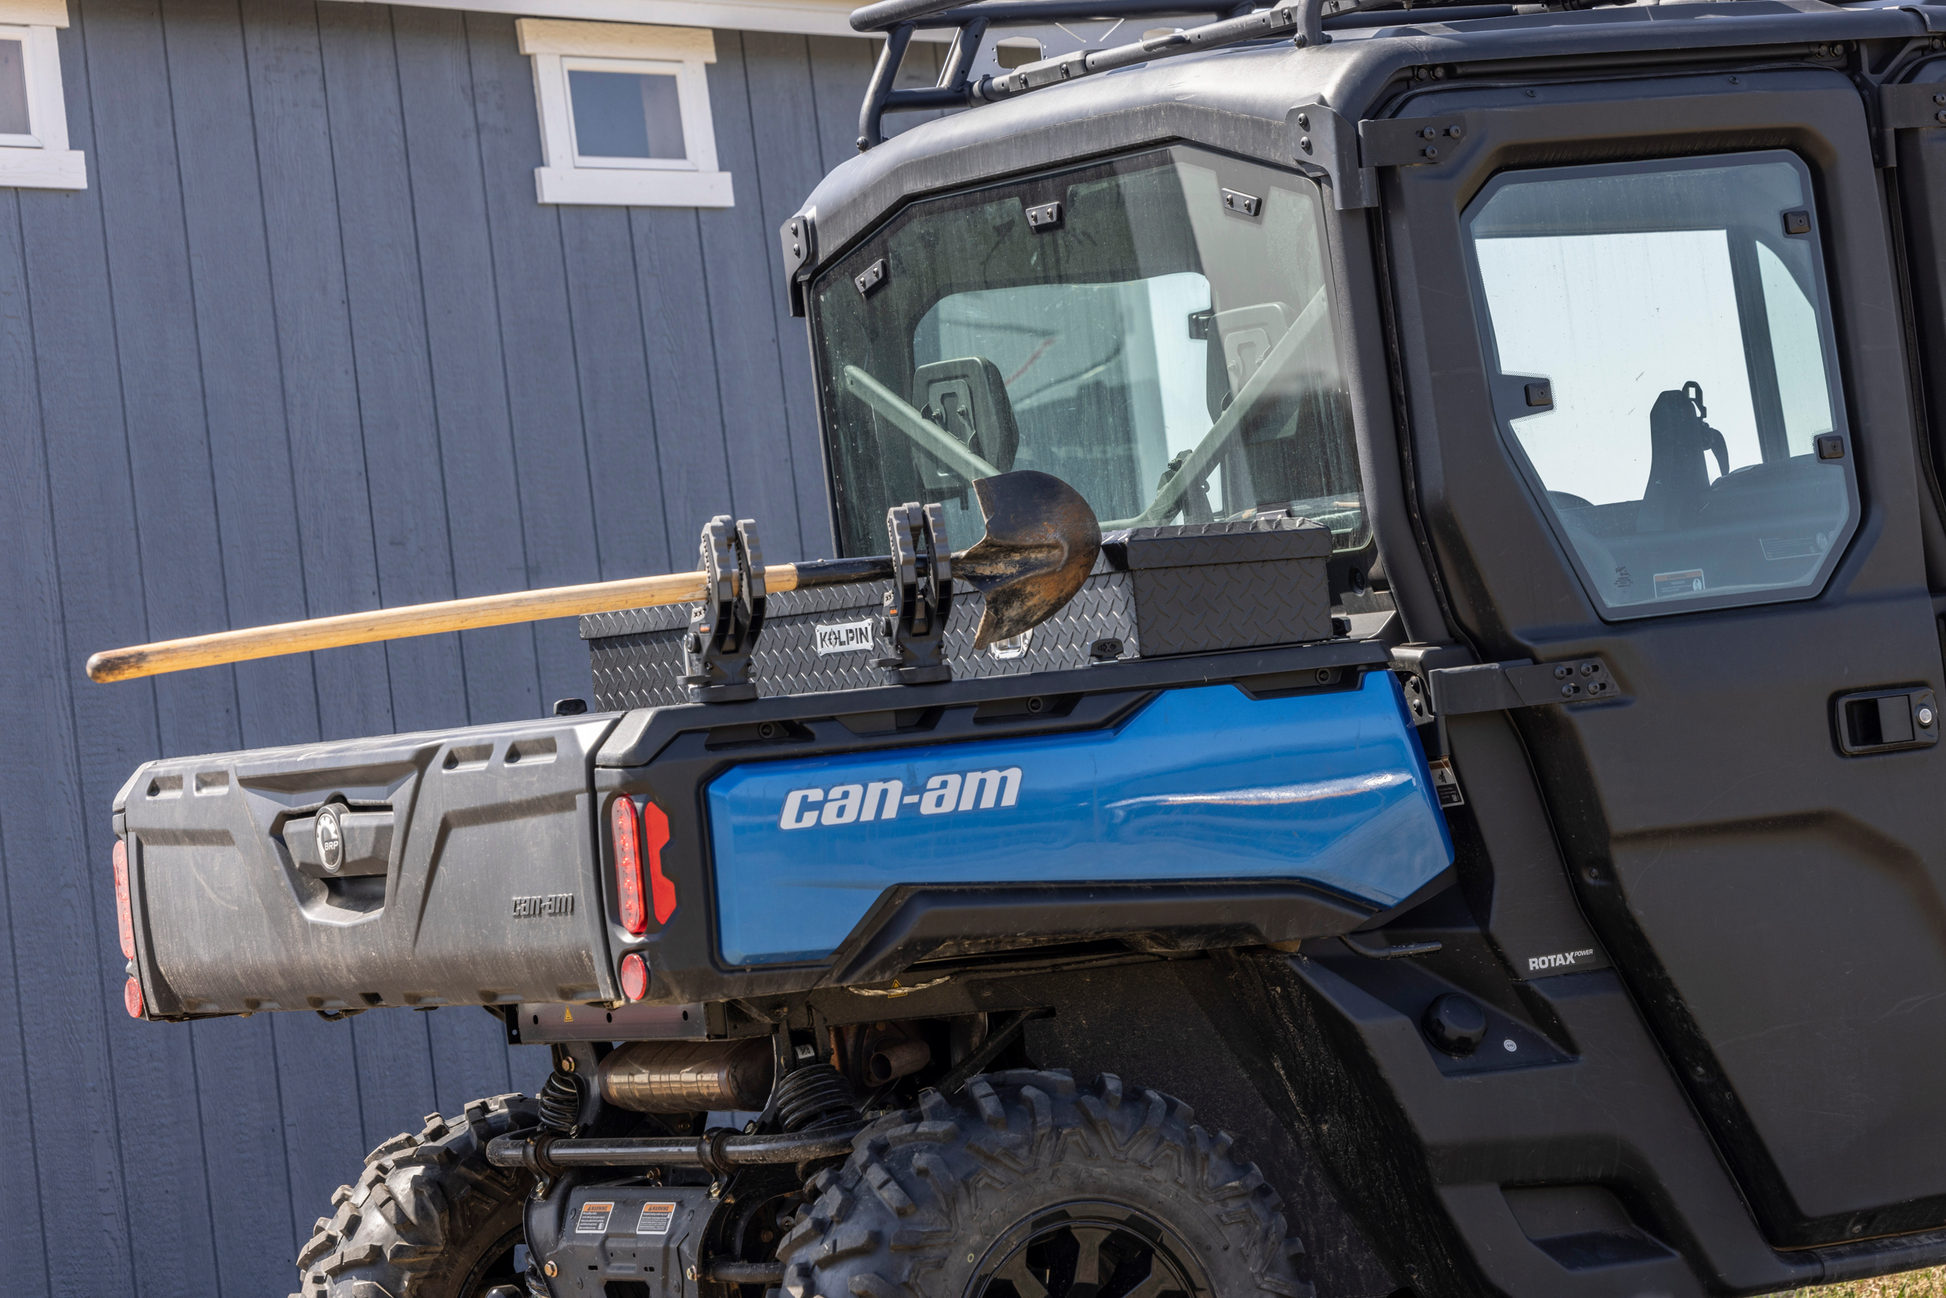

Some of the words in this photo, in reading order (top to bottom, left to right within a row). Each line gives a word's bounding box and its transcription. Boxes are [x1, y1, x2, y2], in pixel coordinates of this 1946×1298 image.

[819, 626, 870, 649] KOLPIN
[779, 767, 1022, 830] can-am
[324, 840, 339, 851] BRP
[512, 892, 575, 916] can-am
[1528, 951, 1575, 970] ROTAX
[1575, 949, 1593, 957] POWER
